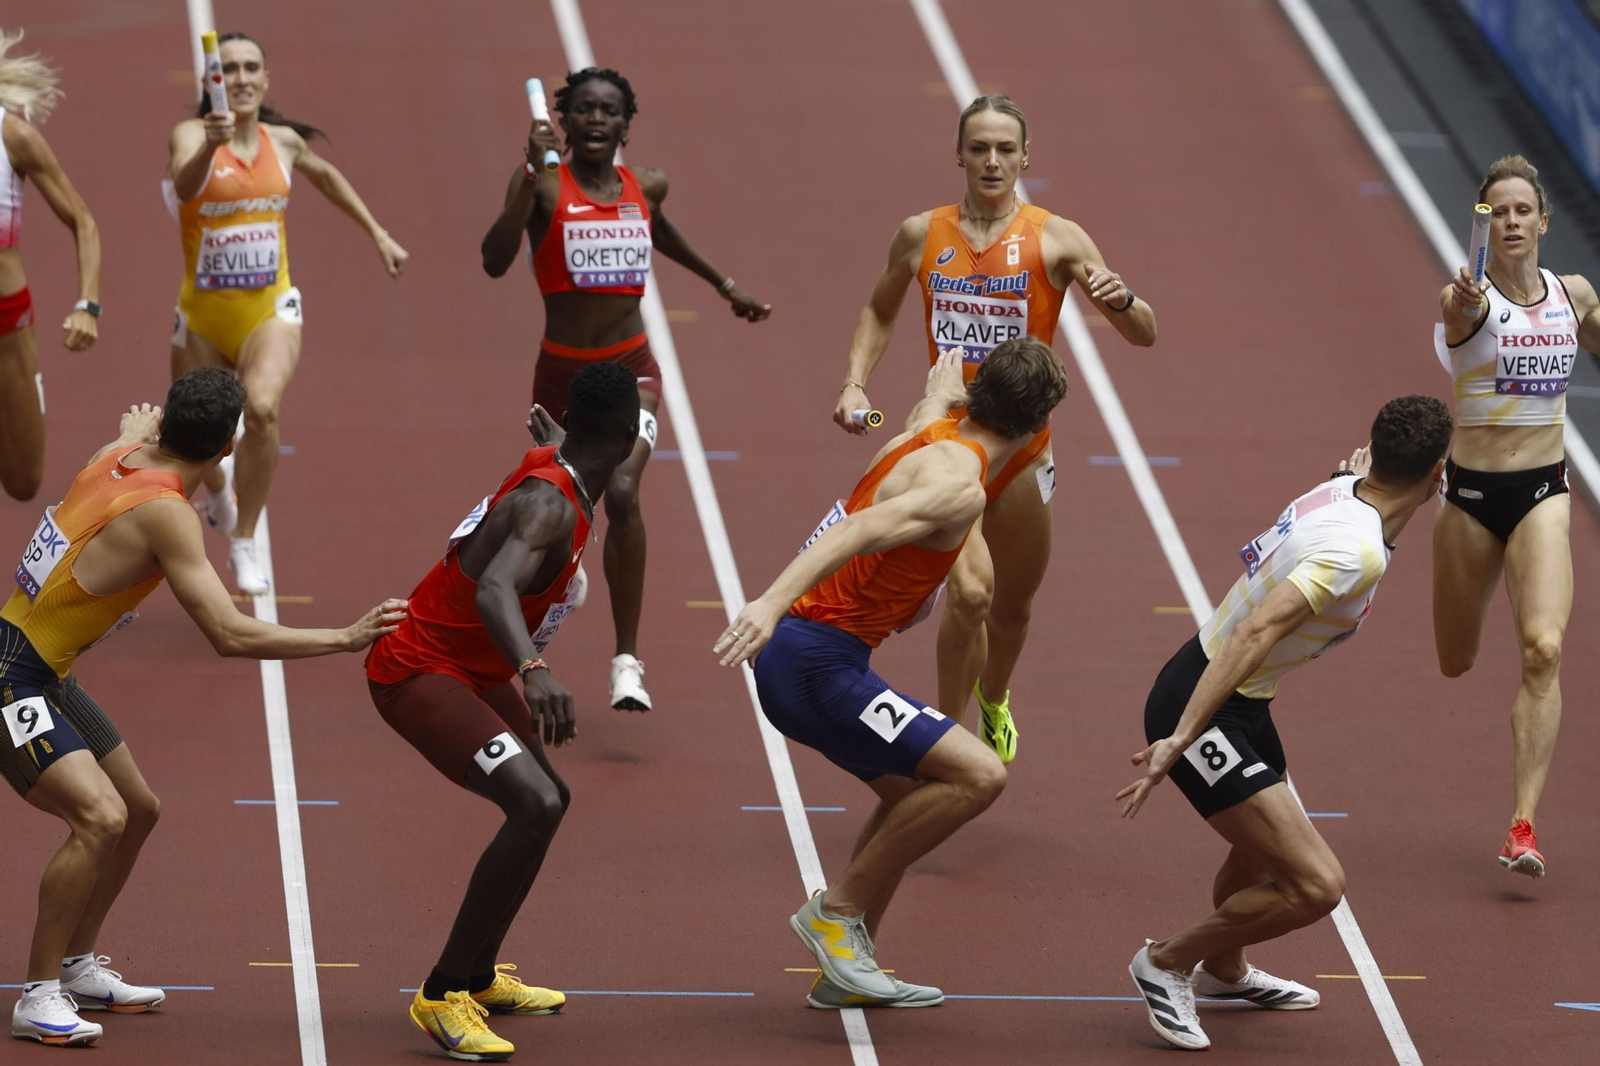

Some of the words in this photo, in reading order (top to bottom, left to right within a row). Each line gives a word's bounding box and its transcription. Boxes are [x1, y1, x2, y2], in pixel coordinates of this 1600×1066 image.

[568, 227, 647, 240] HONDA
[203, 249, 275, 272] SEVILLA
[571, 246, 647, 268] OKETCH
[935, 299, 1025, 318] HONDA
[936, 320, 1021, 345] KLAVER
[1500, 334, 1576, 347] HONDA
[1503, 354, 1575, 376] VERVAET
[645, 419, 655, 441] 6
[24, 539, 43, 564] SP
[17, 705, 39, 734] 9
[874, 702, 907, 729] 2
[1200, 741, 1228, 771] 8
